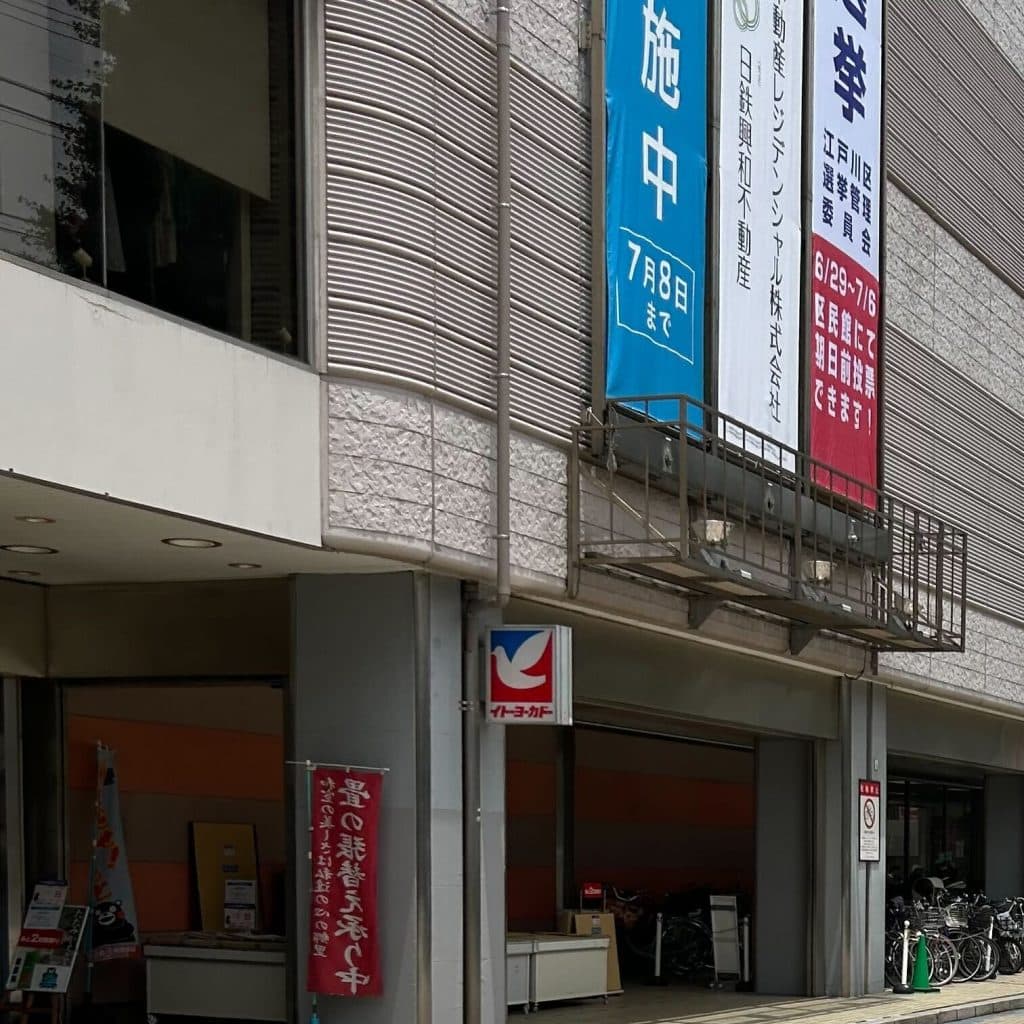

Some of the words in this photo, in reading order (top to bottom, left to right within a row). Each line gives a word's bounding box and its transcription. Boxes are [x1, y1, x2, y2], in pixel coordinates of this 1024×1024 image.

[833, 0, 867, 124] 挙
[641, 0, 681, 222] 施中
[737, 45, 752, 290] 日鉄興和不動産
[823, 127, 872, 192] 江戸川区
[769, 0, 786, 424] 動産レジデンシャル株式会社
[822, 196, 871, 257] 委員会
[627, 240, 688, 314] 7月8日
[645, 302, 672, 338] まで
[814, 292, 876, 358] 区民館にて
[814, 334, 876, 398] 期日前投票
